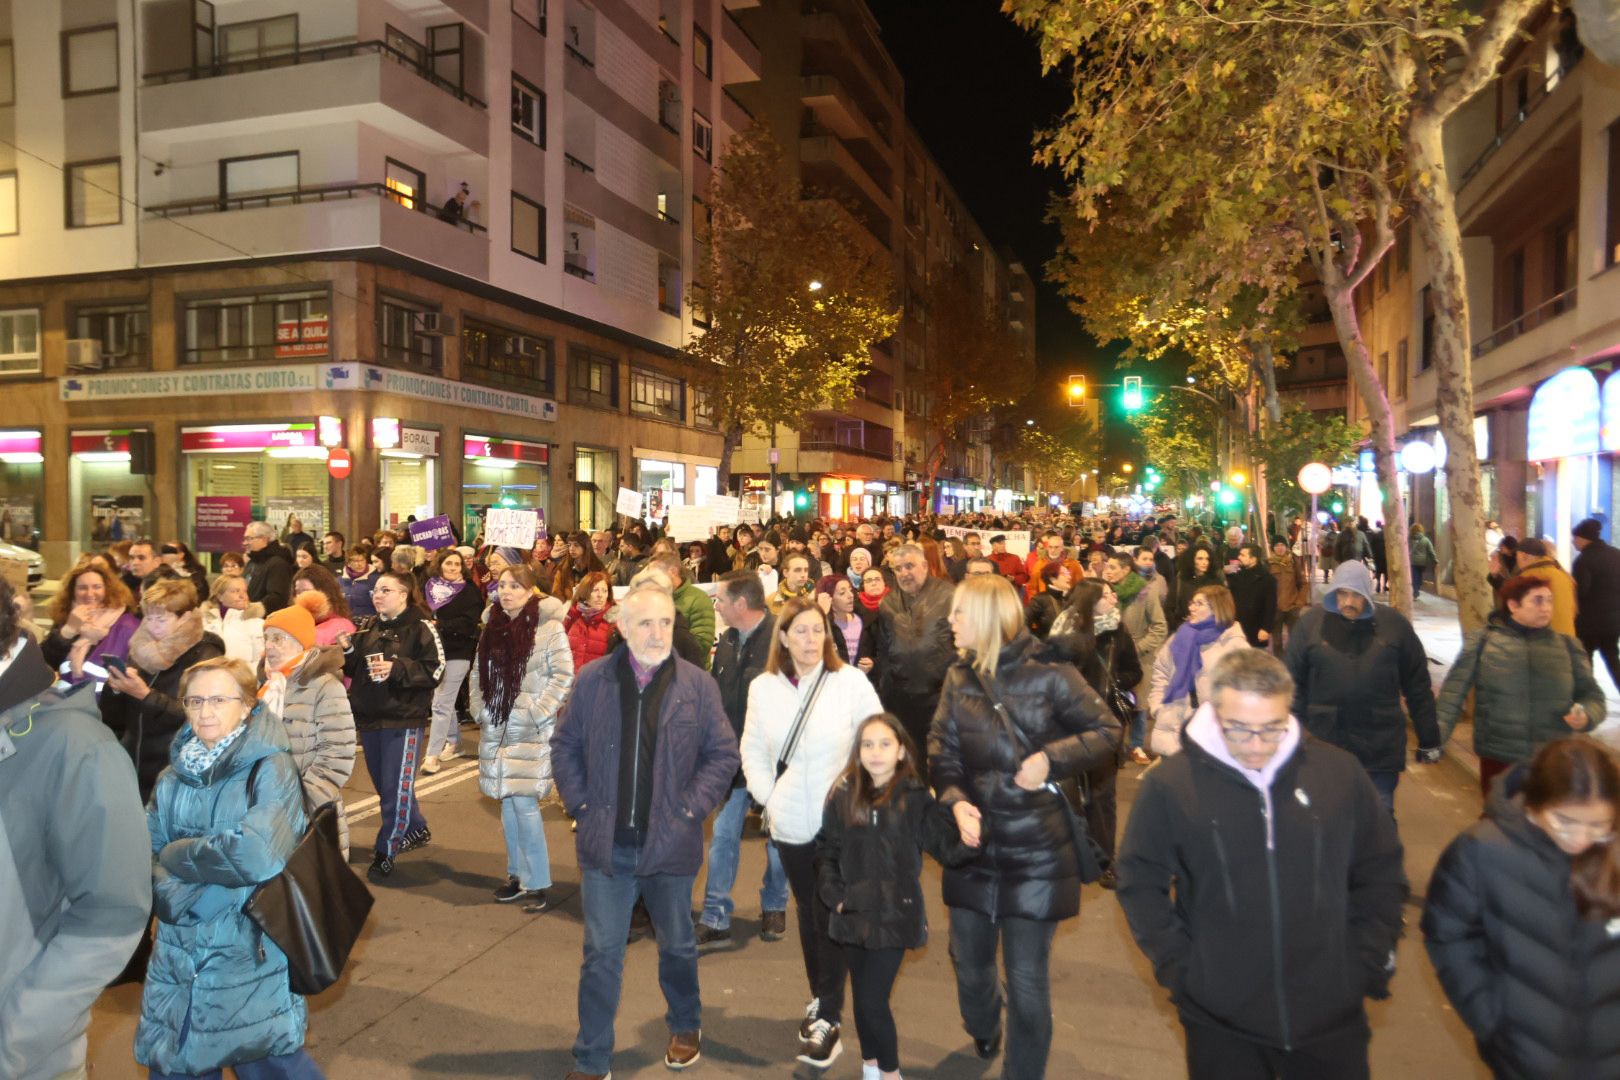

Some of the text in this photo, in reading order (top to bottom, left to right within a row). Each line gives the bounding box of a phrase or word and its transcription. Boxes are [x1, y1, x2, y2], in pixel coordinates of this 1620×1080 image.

[278, 326, 328, 339] SE AQUIL
[88, 376, 170, 396] PROMOCIONES
[171, 377, 180, 392] Y
[183, 373, 252, 392] CONTRATAS
[386, 372, 451, 400] PROMOCIONES
[452, 386, 461, 401] Y
[460, 388, 504, 407] CONTRATAS
